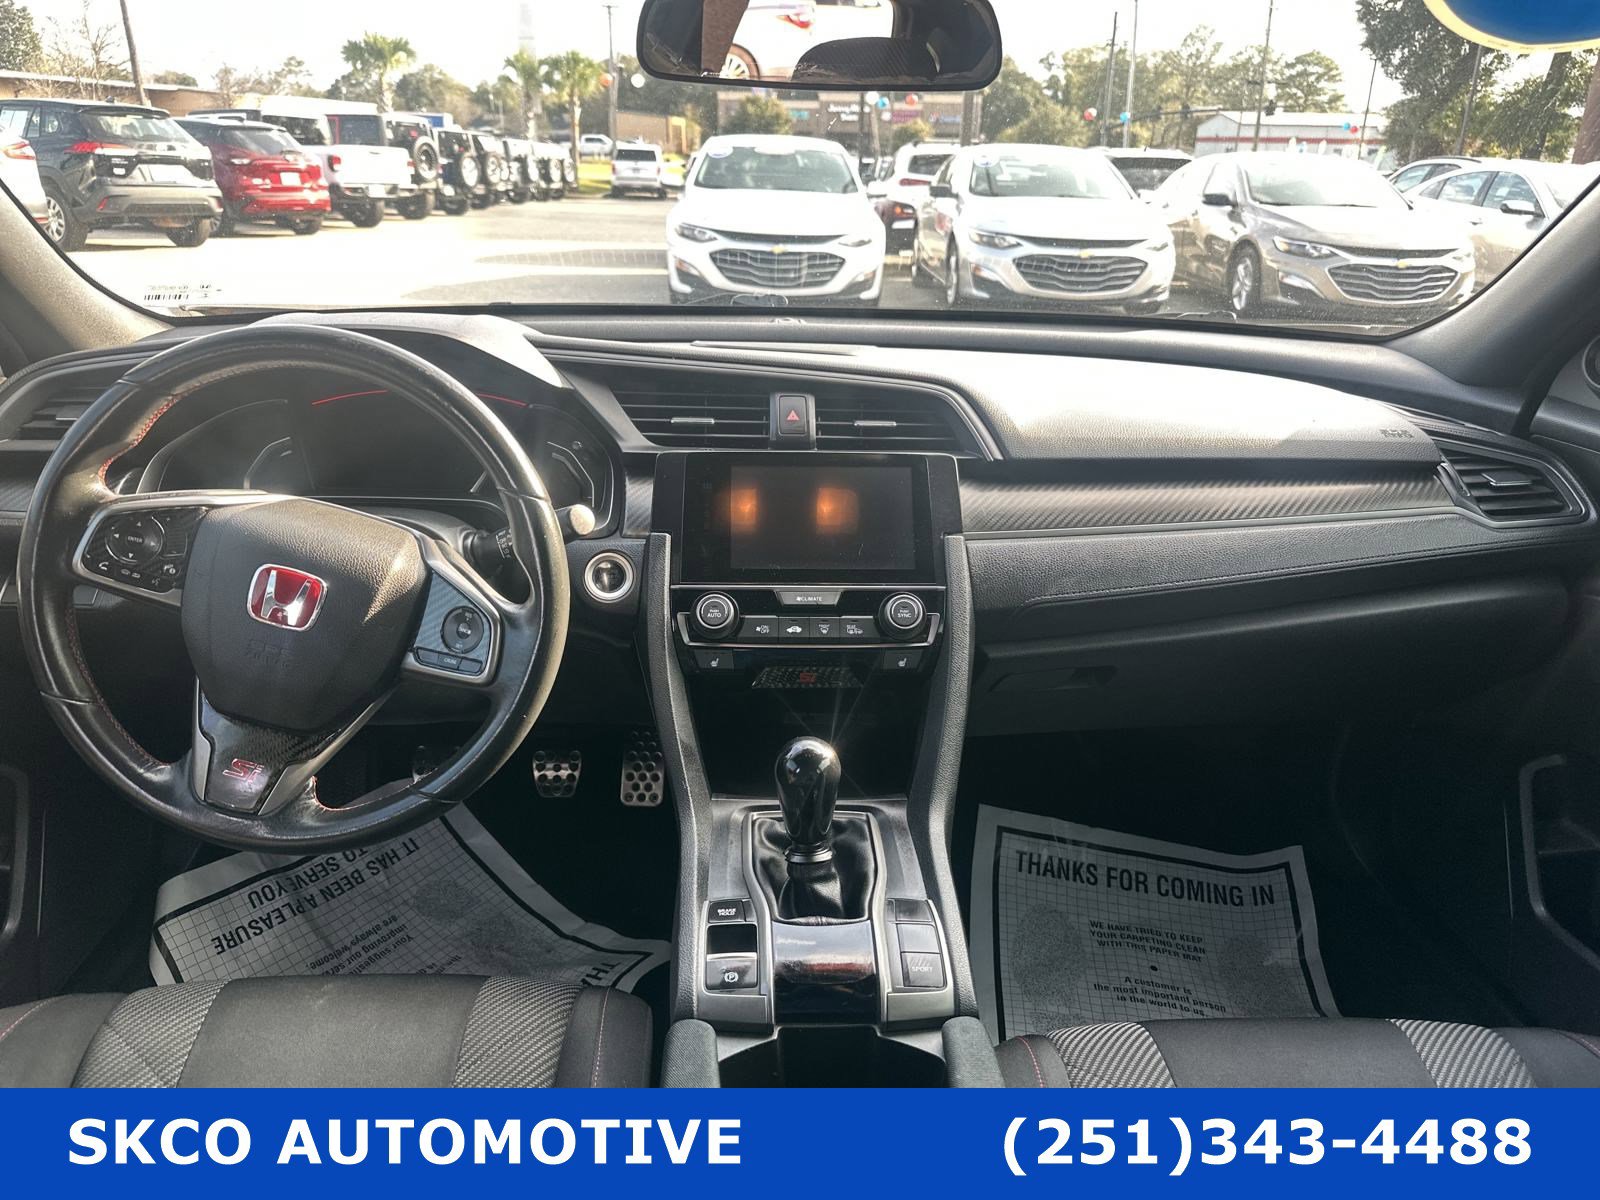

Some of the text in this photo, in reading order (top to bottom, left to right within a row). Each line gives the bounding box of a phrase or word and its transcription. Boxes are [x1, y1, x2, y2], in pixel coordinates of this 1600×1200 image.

[289, 856, 340, 892] SERVE
[1016, 850, 1274, 907] THANKS FOR COMING IN
[210, 838, 419, 955] IT HAS BEEN A PLEASURE
[247, 880, 288, 909] YOU
[383, 914, 398, 927] are
[1090, 920, 1203, 944] WE HAVE TRIED TO KEEP
[350, 923, 382, 946] always
[362, 923, 408, 953] improving
[1090, 930, 1206, 955] YOUR CARPETING CLEAN
[1097, 940, 1202, 963] WITH THIS PAPER MAT
[1124, 976, 1132, 984] A
[1134, 978, 1180, 992] customer
[1094, 983, 1227, 1013] the most important person
[1130, 995, 1146, 1004] the
[1148, 998, 1178, 1010] world
[1180, 1003, 1191, 1013] to
